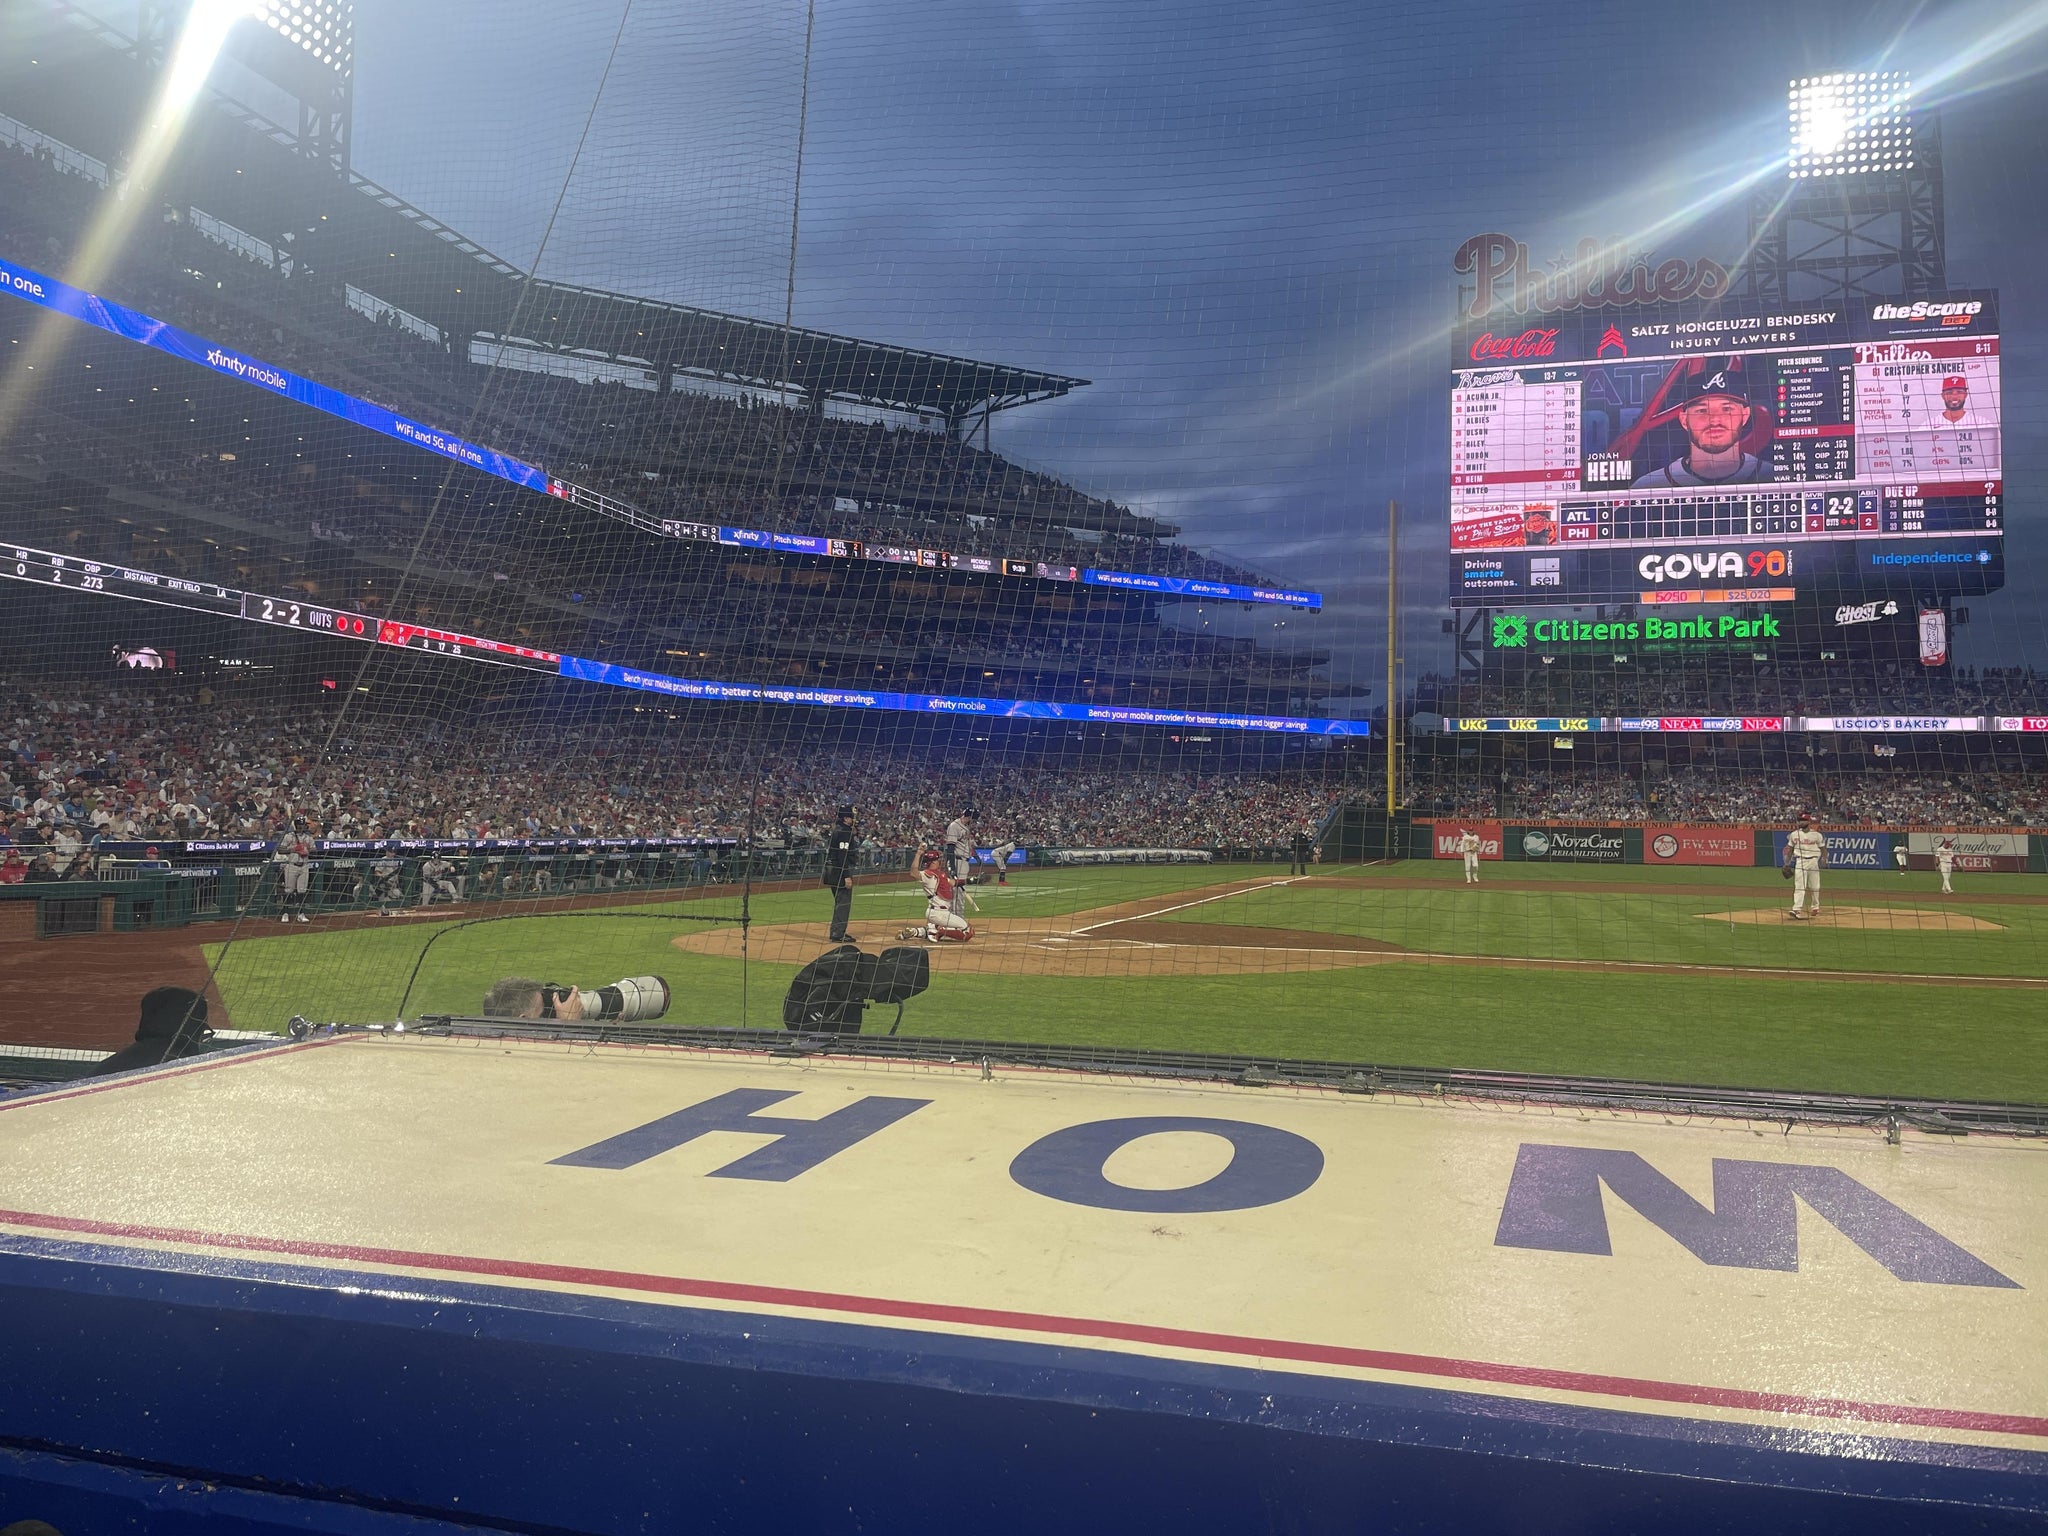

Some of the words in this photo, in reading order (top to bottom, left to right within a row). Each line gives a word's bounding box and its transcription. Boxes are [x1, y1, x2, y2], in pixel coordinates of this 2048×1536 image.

[1453, 232, 1730, 317] Phillies
[13, 276, 46, 298] one.
[1872, 301, 1983, 319] theScore
[1631, 324, 1670, 337] SALTZ
[1676, 317, 1761, 334] MONGELUZZI
[1767, 312, 1837, 327] BENDESKY
[1670, 337, 1722, 348] INJURY
[1732, 331, 1796, 344] LAWYERS
[1975, 343, 1992, 353] 8-11
[1855, 344, 1933, 364] Phillies
[1778, 359, 1795, 367] PITCH
[1795, 356, 1823, 365] SEQUENCE
[206, 350, 247, 375] xfinity
[247, 366, 287, 390] mobile
[1884, 365, 1930, 376] CRISTOPHER
[396, 420, 414, 436] WiFi
[414, 429, 431, 444] and
[431, 435, 447, 452] 5G,
[466, 450, 484, 465] one.
[1587, 452, 1619, 460] JONAH
[1587, 460, 1633, 482] HEIM
[1884, 486, 1904, 498] DUE
[1905, 484, 1919, 496] UP
[1772, 504, 1780, 512] 2
[1790, 503, 1798, 512] 0
[1811, 502, 1819, 511] 4
[1828, 497, 1855, 515] 2-2
[1865, 501, 1873, 509] 2
[1567, 511, 1591, 522] ATL
[1602, 511, 1609, 519] 0
[1902, 510, 1925, 519] REYES
[1755, 522, 1763, 531] 0
[1790, 520, 1798, 529] 0
[1811, 519, 1819, 528] 4
[1865, 517, 1873, 526] 2
[1902, 522, 1922, 531] SOSA
[733, 530, 760, 542] xfinity
[1568, 527, 1590, 538] PHI
[1602, 528, 1609, 537] 0
[773, 534, 792, 544] Pitch
[792, 536, 817, 549] Speed
[832, 541, 847, 549] STL
[832, 548, 848, 557] HOU
[923, 551, 937, 560] CIN
[16, 549, 28, 560] HR
[52, 557, 64, 568] RBI
[84, 564, 101, 575] OBP
[1464, 559, 1503, 570] Driving
[1872, 551, 1974, 567] Independence
[17, 564, 26, 576] 0
[1638, 551, 1744, 583] GOYA
[1746, 550, 1786, 577] 90
[53, 570, 62, 583] 2
[124, 570, 159, 587] DISTANCE
[1464, 570, 1504, 579] smarter
[80, 575, 104, 592] .273
[168, 579, 184, 589] EXIT
[183, 581, 201, 594] VELO
[1464, 578, 1518, 588] outcomes.
[217, 588, 227, 599] LA
[1210, 586, 1231, 596] mobile
[1728, 589, 1771, 601] $25,020
[1834, 600, 1886, 626] GHOST
[309, 611, 333, 631] OUTS
[1533, 618, 1640, 642] Citizens
[1645, 614, 1713, 640] Bank
[1718, 612, 1780, 638] Park
[623, 672, 641, 685] Bench
[641, 676, 655, 687] your
[655, 678, 673, 690] mobile
[673, 684, 702, 697] provider
[704, 684, 719, 695] for
[721, 686, 751, 698] better
[752, 689, 796, 702] coverage
[796, 689, 814, 701] and
[814, 691, 843, 705] bigger
[844, 694, 878, 707] savings.
[928, 699, 957, 712] xfinity
[957, 700, 987, 712] mobile
[1088, 708, 1111, 719] Bench
[1111, 711, 1129, 721] your
[1129, 711, 1154, 721] mobile
[1154, 713, 1184, 725] provider
[1184, 714, 1195, 723] for
[1196, 716, 1218, 726] better
[1218, 717, 1249, 729] coverage
[1248, 717, 1263, 728] and
[1263, 718, 1284, 731] bigger
[1284, 721, 1309, 732] savings.
[1458, 719, 1488, 730] UKG
[1508, 719, 1538, 730] UKG
[1558, 719, 1589, 730] UKG
[1663, 719, 1700, 729] NECA
[1745, 719, 1782, 729] NECA
[1834, 718, 1890, 728] LISCIO'S
[1894, 718, 1948, 728] BAKERY
[1435, 818, 1487, 826] ASPLUNDH
[1495, 819, 1548, 827] ASPLUNDH
[1556, 820, 1610, 828] ASPLUNDH
[1619, 821, 1673, 829] ASPLUNDH
[1683, 822, 1738, 830] ASPLUNDH
[1750, 823, 1797, 831] ASPLUND
[1817, 824, 1874, 832] ASPLUNDH
[1885, 825, 1943, 833] ASPLUNDH
[195, 842, 216, 850] Citizens
[1551, 833, 1623, 848] NovaCare
[1682, 839, 1705, 850] F.W.
[1707, 838, 1748, 850] WEBB
[1825, 837, 1877, 849] ERWIN
[1551, 848, 1621, 858] REHABILITATION
[1695, 850, 1733, 858] COMPANY
[1952, 856, 1992, 868] AGER
